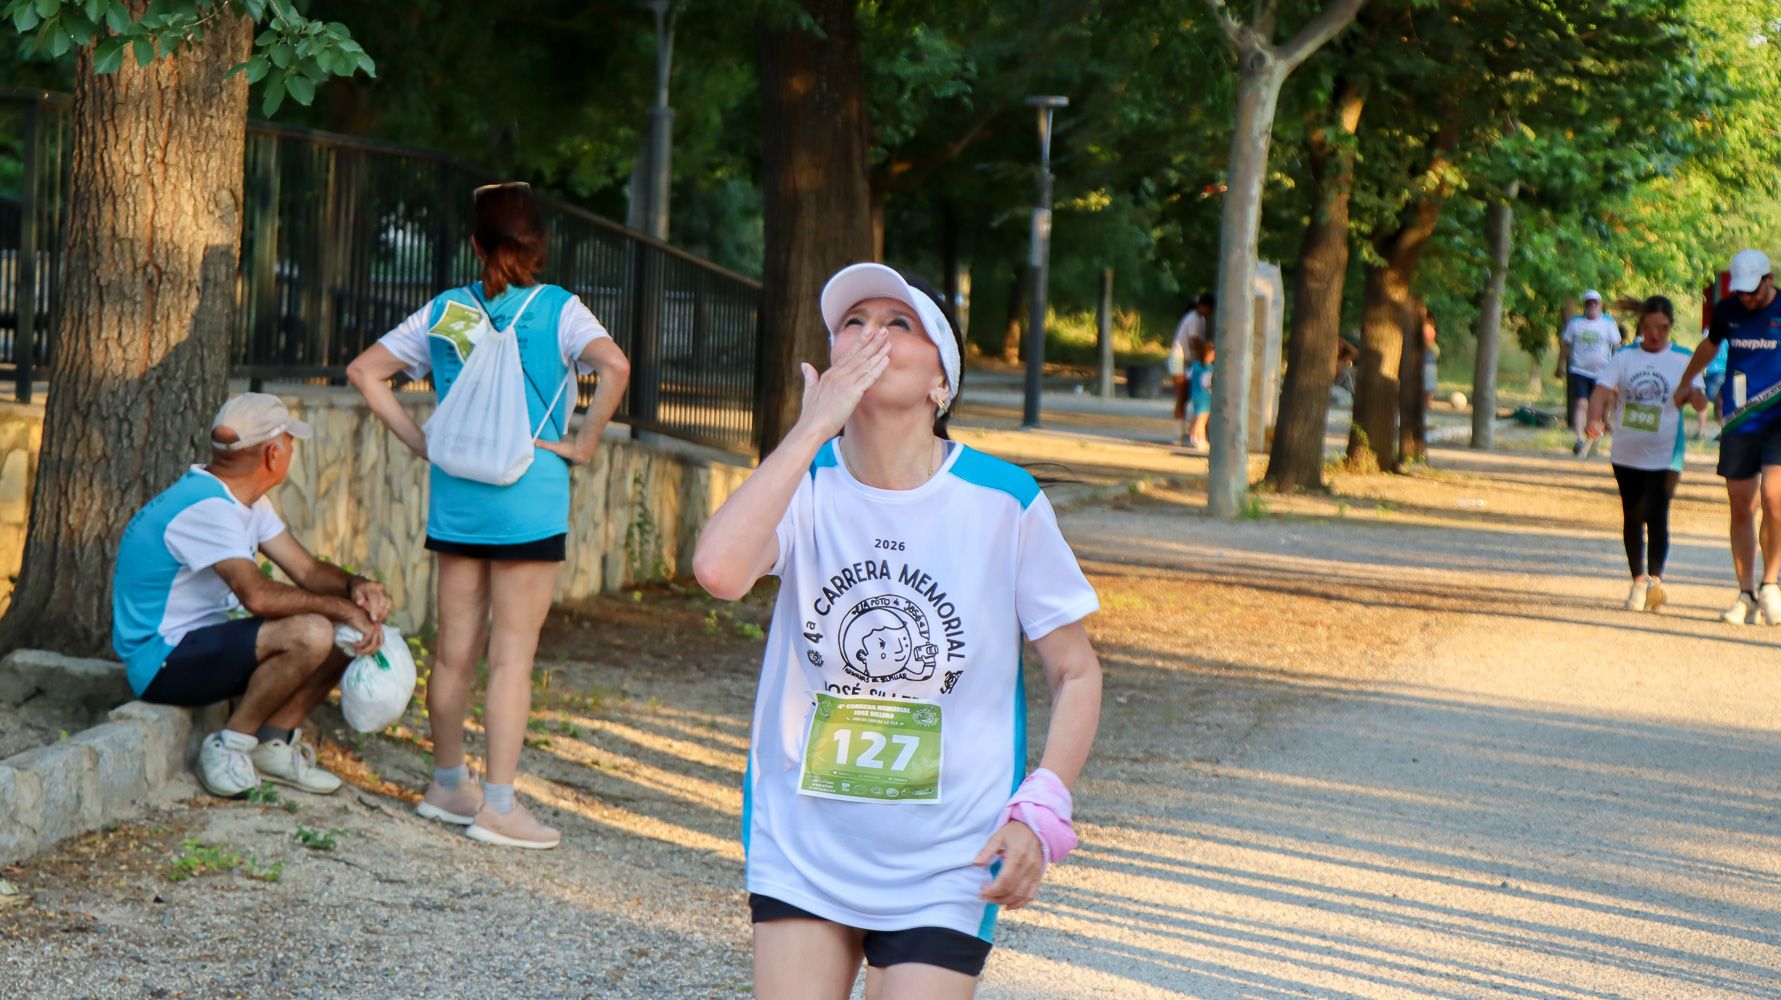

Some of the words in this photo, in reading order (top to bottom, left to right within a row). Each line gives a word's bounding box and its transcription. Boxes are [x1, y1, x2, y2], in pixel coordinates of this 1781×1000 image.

[874, 538, 906, 552] 2026
[814, 559, 891, 616] CARRERA
[898, 563, 966, 662] MEMORIAL
[833, 728, 921, 772] 127
